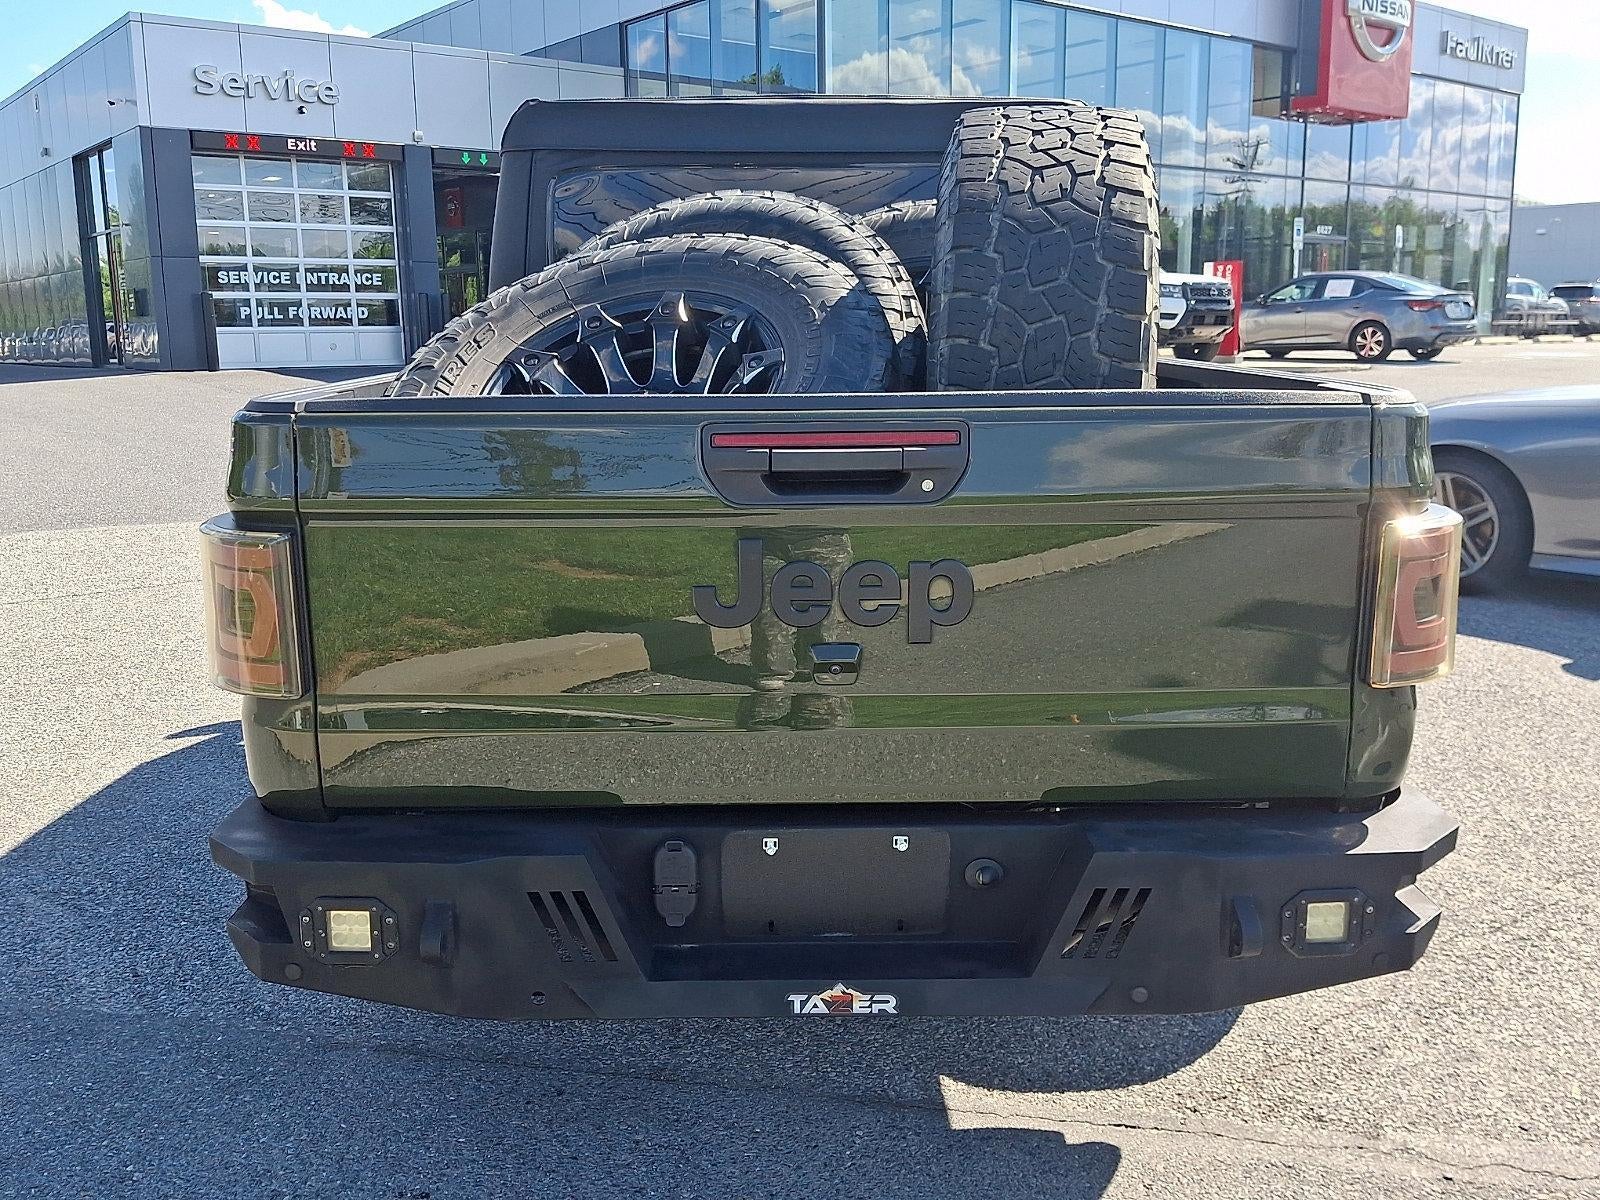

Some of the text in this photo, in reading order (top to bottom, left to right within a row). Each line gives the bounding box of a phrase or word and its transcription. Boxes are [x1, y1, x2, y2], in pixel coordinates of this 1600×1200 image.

[1362, 0, 1409, 20] NISSAN
[1442, 30, 1517, 69] Faulkner
[194, 65, 340, 105] Service
[287, 138, 317, 151] Exit
[217, 271, 291, 284] SERVICE
[240, 306, 283, 319] PULL
[430, 322, 497, 396] IRES
[692, 538, 975, 645] Jeep
[787, 994, 899, 1014] TAZER
